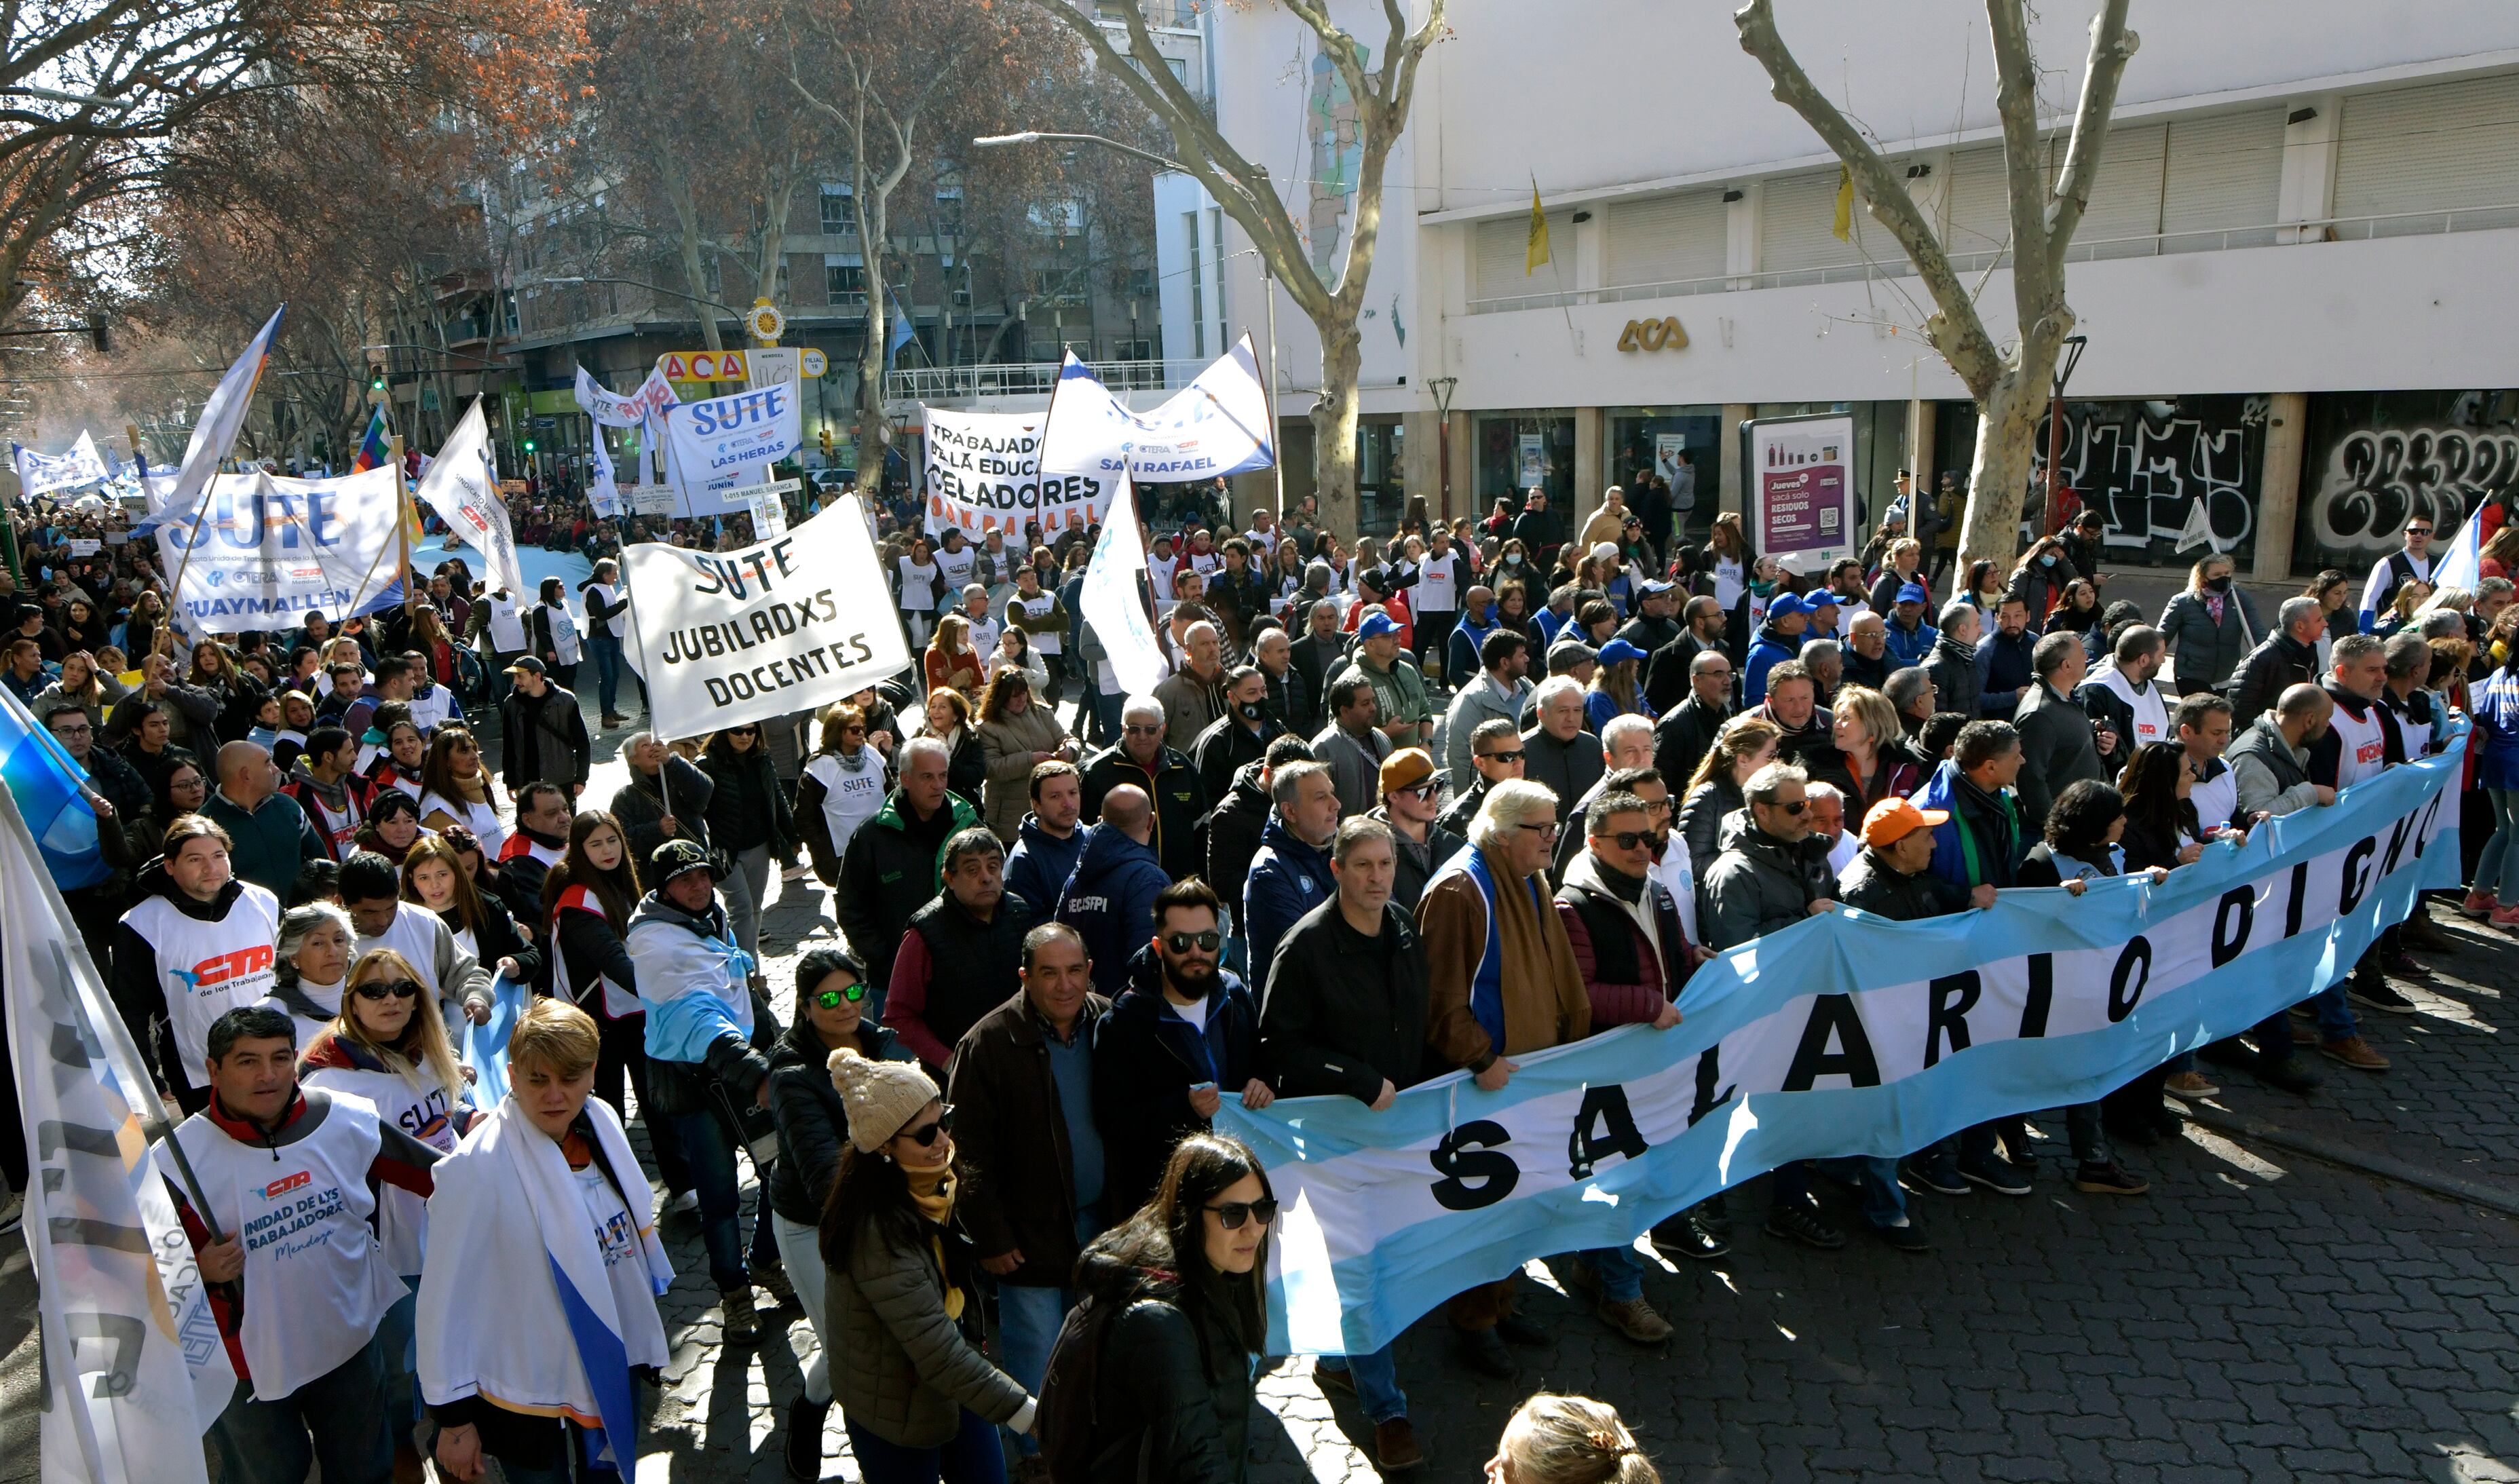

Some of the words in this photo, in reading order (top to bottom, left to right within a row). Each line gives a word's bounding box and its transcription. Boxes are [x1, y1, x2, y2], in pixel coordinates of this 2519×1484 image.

[1617, 316, 1690, 352] ACA
[666, 354, 741, 379] ACA
[692, 387, 785, 436] SUTE
[711, 455, 736, 470] LAS
[738, 440, 785, 461] HERAS
[1139, 444, 1171, 454] CTERA
[1143, 457, 1217, 473] RAFAEL
[35, 478, 64, 489] SANTA
[455, 473, 485, 505] SINDICATO
[707, 480, 734, 491] JUNÍN
[740, 487, 765, 497] MANUEL
[927, 463, 1101, 510] CELADORES
[1771, 480, 1801, 491] Jueves
[1771, 492, 1790, 502] sacá
[1792, 491, 1810, 499] solo
[472, 501, 480, 512] DE
[479, 509, 487, 519] LA
[1771, 501, 1809, 514] RESIDUOS
[164, 491, 341, 550] SUTE
[1771, 514, 1797, 525] SECOS
[233, 571, 281, 584] CTERA
[290, 567, 322, 577] CTA
[695, 536, 799, 601] SUTE
[948, 563, 971, 574] SUTE
[662, 588, 837, 665] JUBILADXS
[974, 632, 991, 641] SUTE
[704, 632, 872, 708] DOCENTES
[843, 776, 875, 793] SUTE
[191, 944, 273, 987] CTA
[214, 984, 230, 993] los
[1429, 934, 2153, 1212] SALARIO
[2212, 786, 2444, 970] DIGNO
[265, 1170, 311, 1198] CTA
[297, 1196, 316, 1213] DE
[318, 1187, 340, 1205] LXS
[275, 1228, 335, 1261] Mendoza
